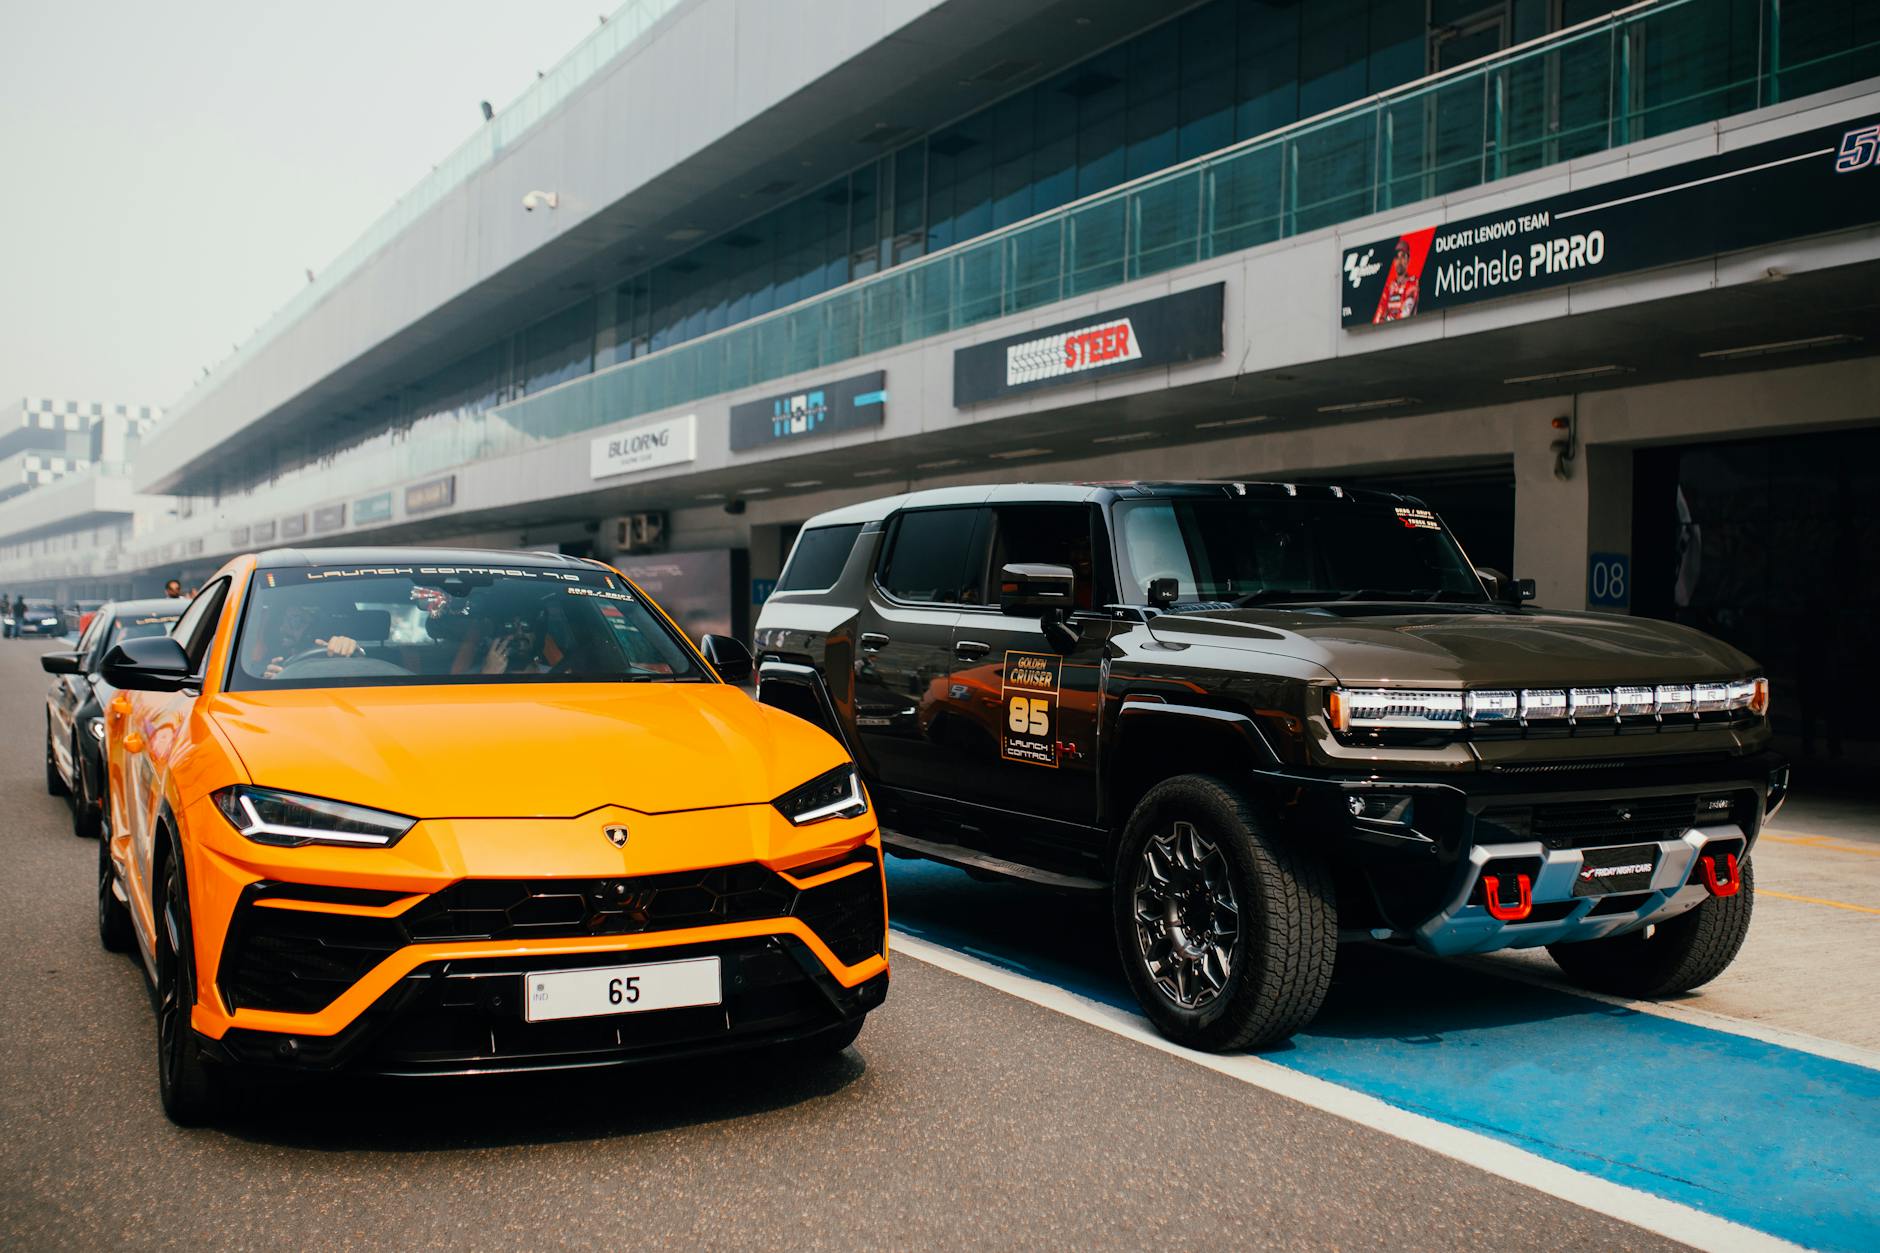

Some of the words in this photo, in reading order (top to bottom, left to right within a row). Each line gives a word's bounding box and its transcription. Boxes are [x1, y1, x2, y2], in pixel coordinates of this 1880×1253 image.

[1836, 125, 1880, 172] 5
[1435, 233, 1473, 253] DUCATI
[1475, 222, 1516, 245] LENOVO
[1518, 211, 1550, 235] TEAM
[1434, 248, 1523, 297] Michele
[1530, 230, 1605, 278] PIRRO
[1064, 323, 1130, 369] STEER
[307, 567, 413, 580] LAUNCH
[420, 567, 537, 578] CONTROL
[1593, 562, 1625, 599] 08
[1017, 656, 1047, 669] GOLDEN
[1009, 668, 1053, 688] CRUISER
[1009, 696, 1049, 737] 85
[1007, 748, 1052, 762] CONTROL
[1009, 738, 1049, 752] LAUNCH
[1594, 867, 1616, 878] FRIDAY
[1616, 865, 1636, 875] NIGHT
[1635, 863, 1653, 874] CARS
[533, 993, 549, 1001] IND
[608, 975, 641, 1005] 65
